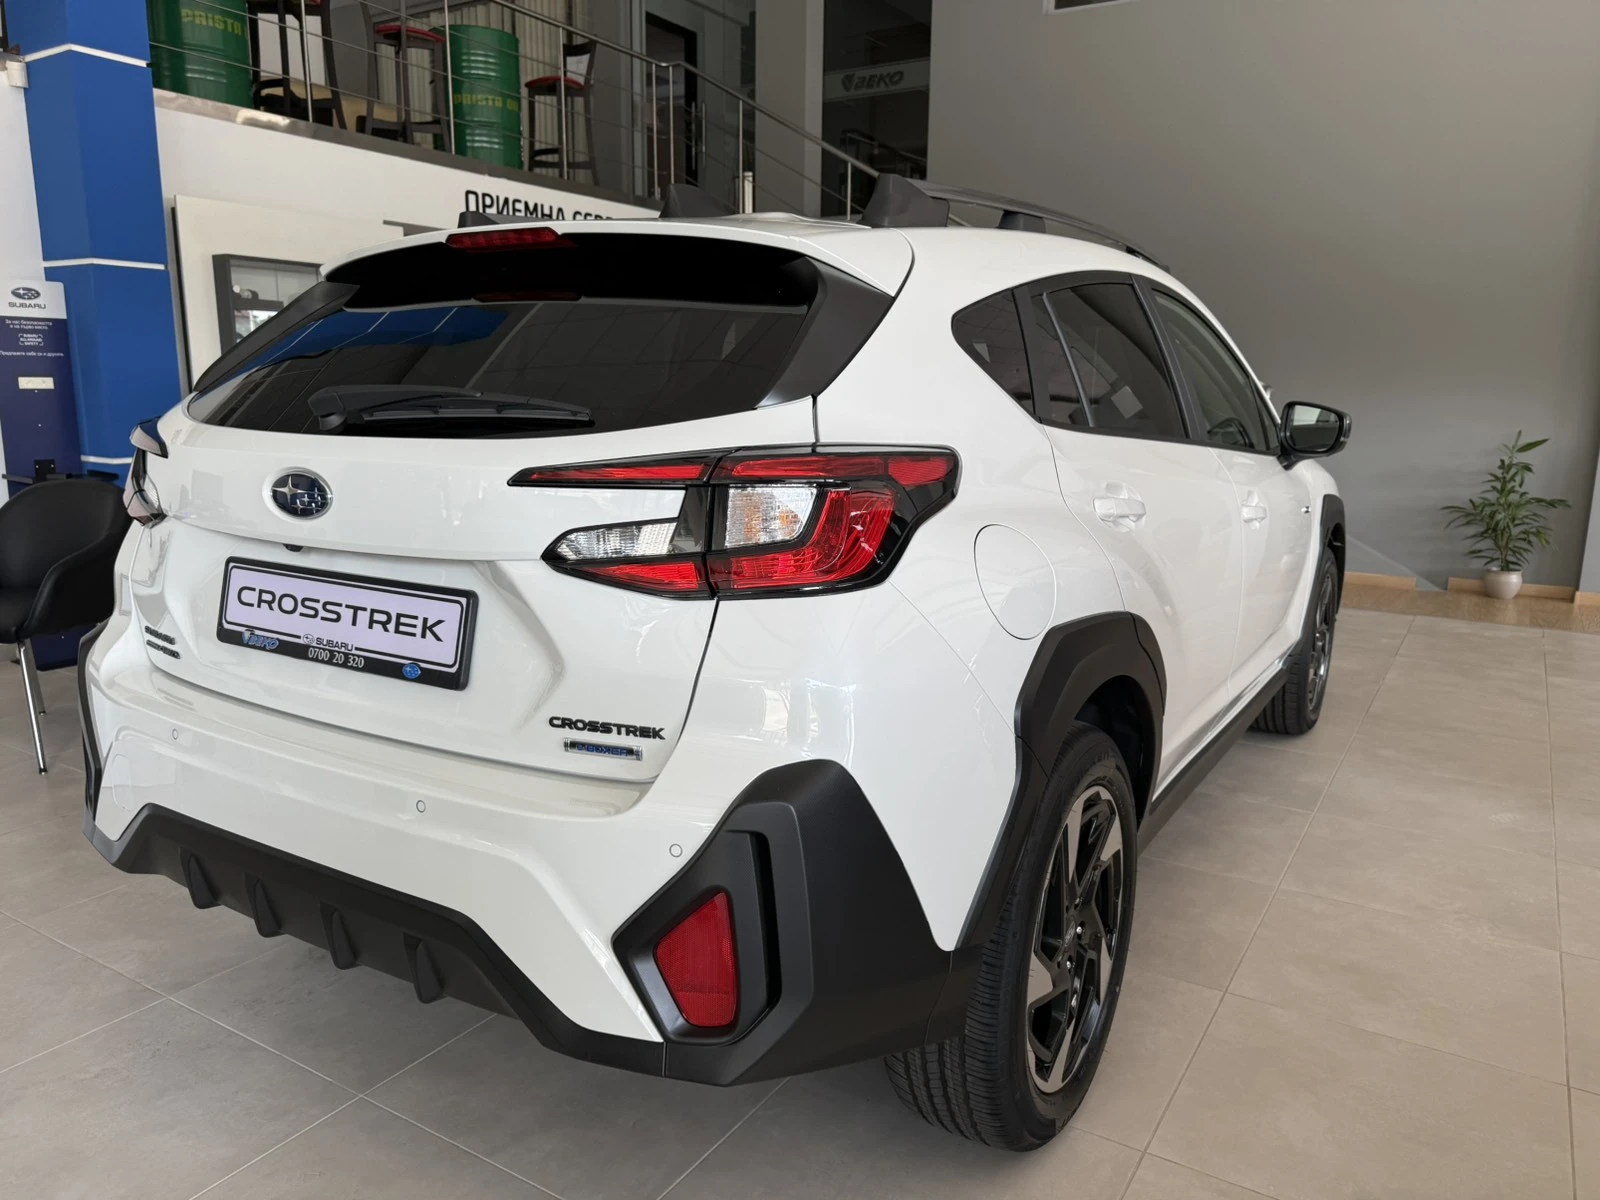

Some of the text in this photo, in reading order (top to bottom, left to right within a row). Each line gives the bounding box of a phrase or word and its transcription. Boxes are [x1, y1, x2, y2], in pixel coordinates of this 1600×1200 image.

[180, 8, 241, 36] PRISTA
[8, 301, 47, 309] SUBARU
[237, 585, 446, 642] CROSSTREK
[315, 637, 354, 651] SUBARU
[308, 647, 365, 668] 0700 20 320
[548, 716, 666, 740] CROSSTREK
